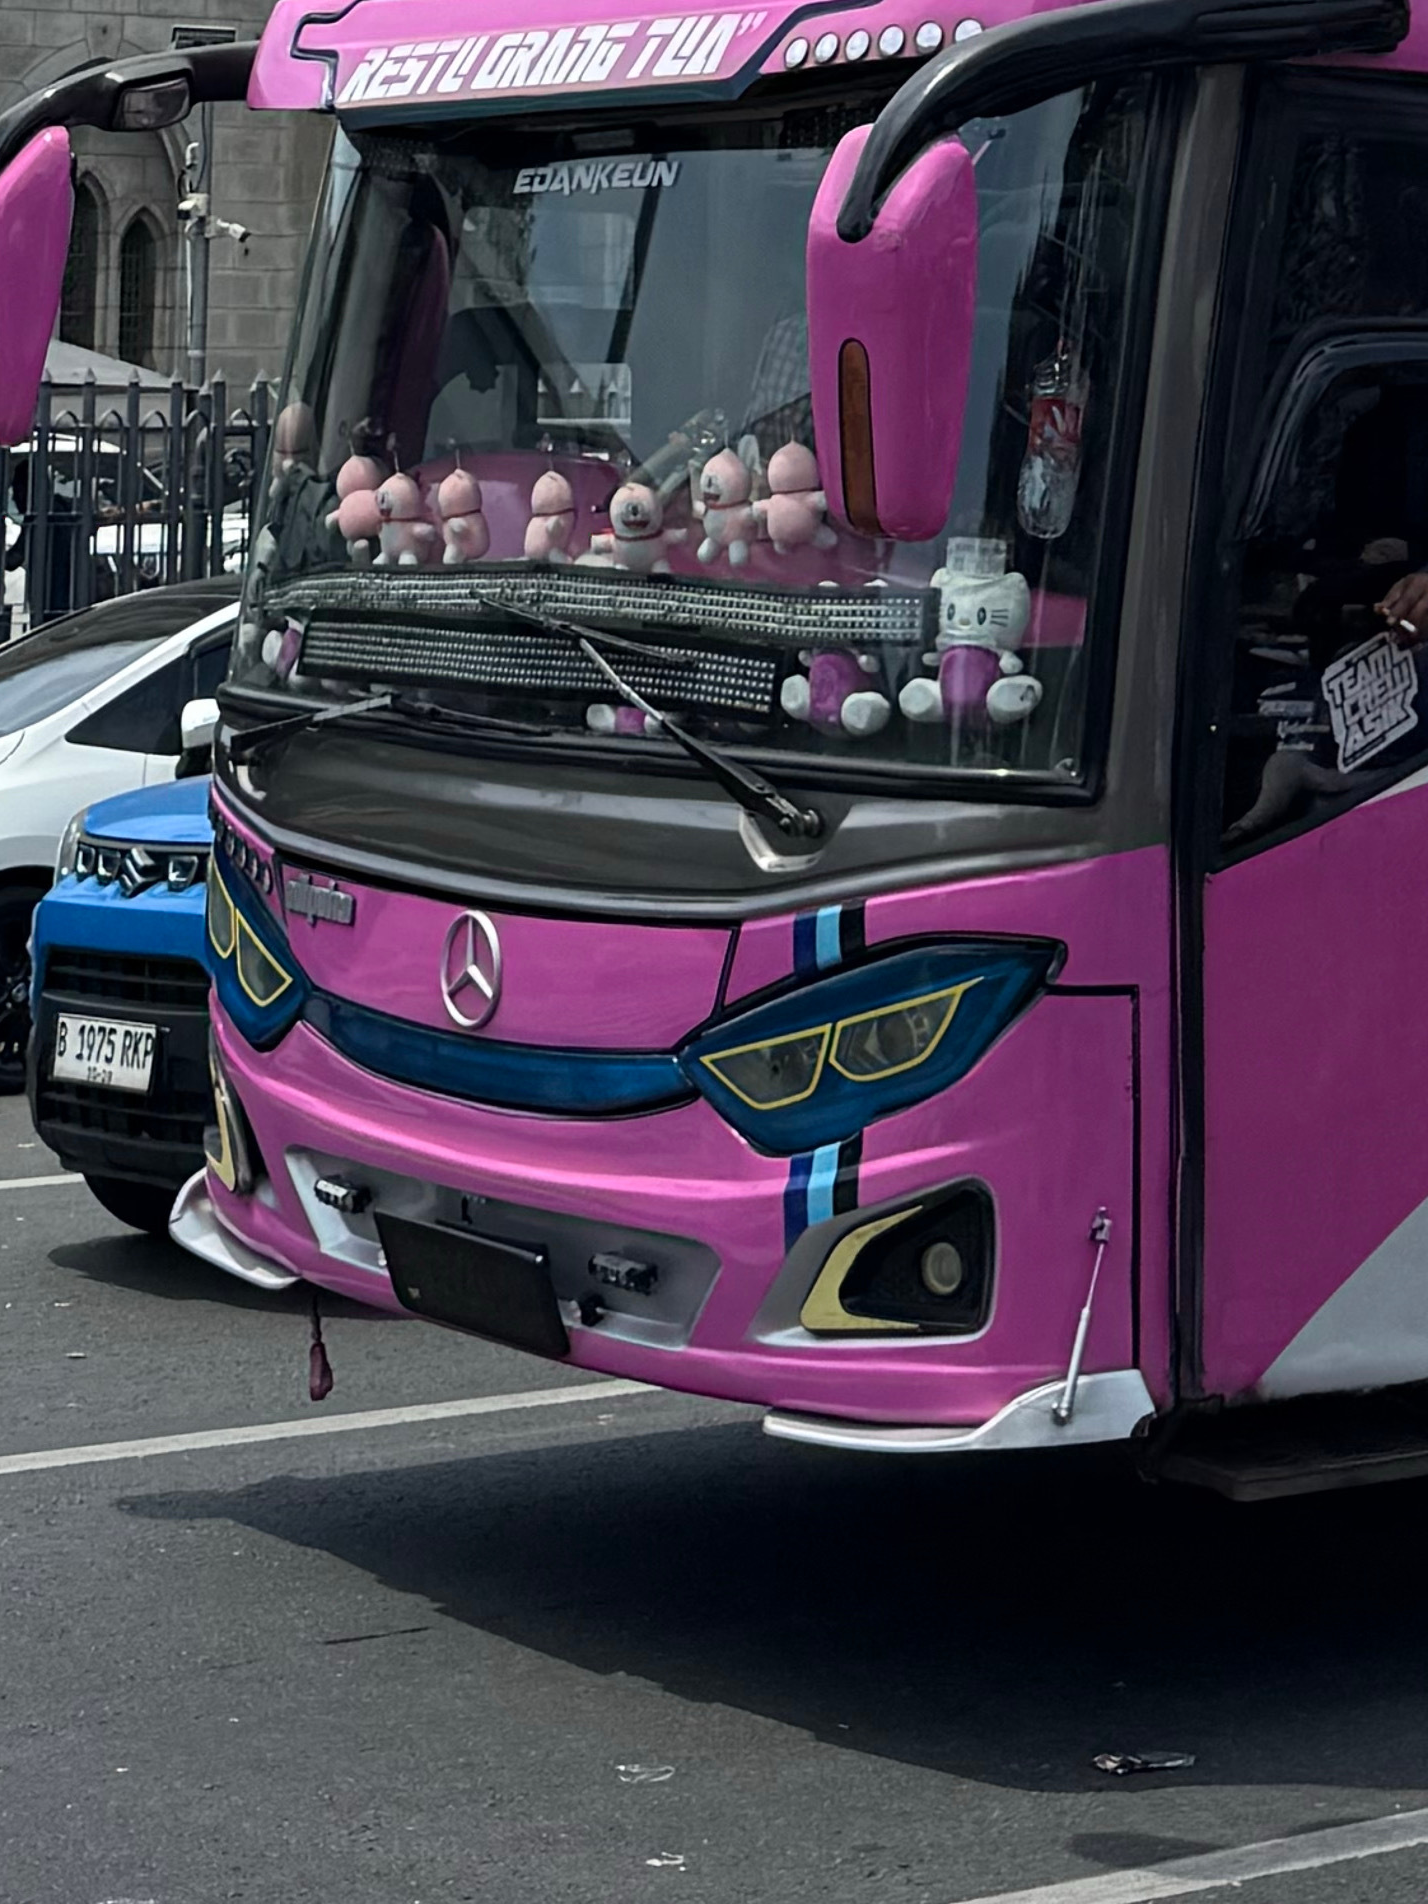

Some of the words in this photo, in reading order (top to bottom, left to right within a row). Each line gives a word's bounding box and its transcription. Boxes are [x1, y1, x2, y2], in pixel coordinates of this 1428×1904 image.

[336, 35, 490, 104] RESTU
[513, 160, 680, 196] EDANKEUN
[1327, 644, 1393, 707] TEAM
[57, 1020, 69, 1058] B
[75, 1024, 117, 1064] 1975
[120, 1029, 156, 1070] RKP
